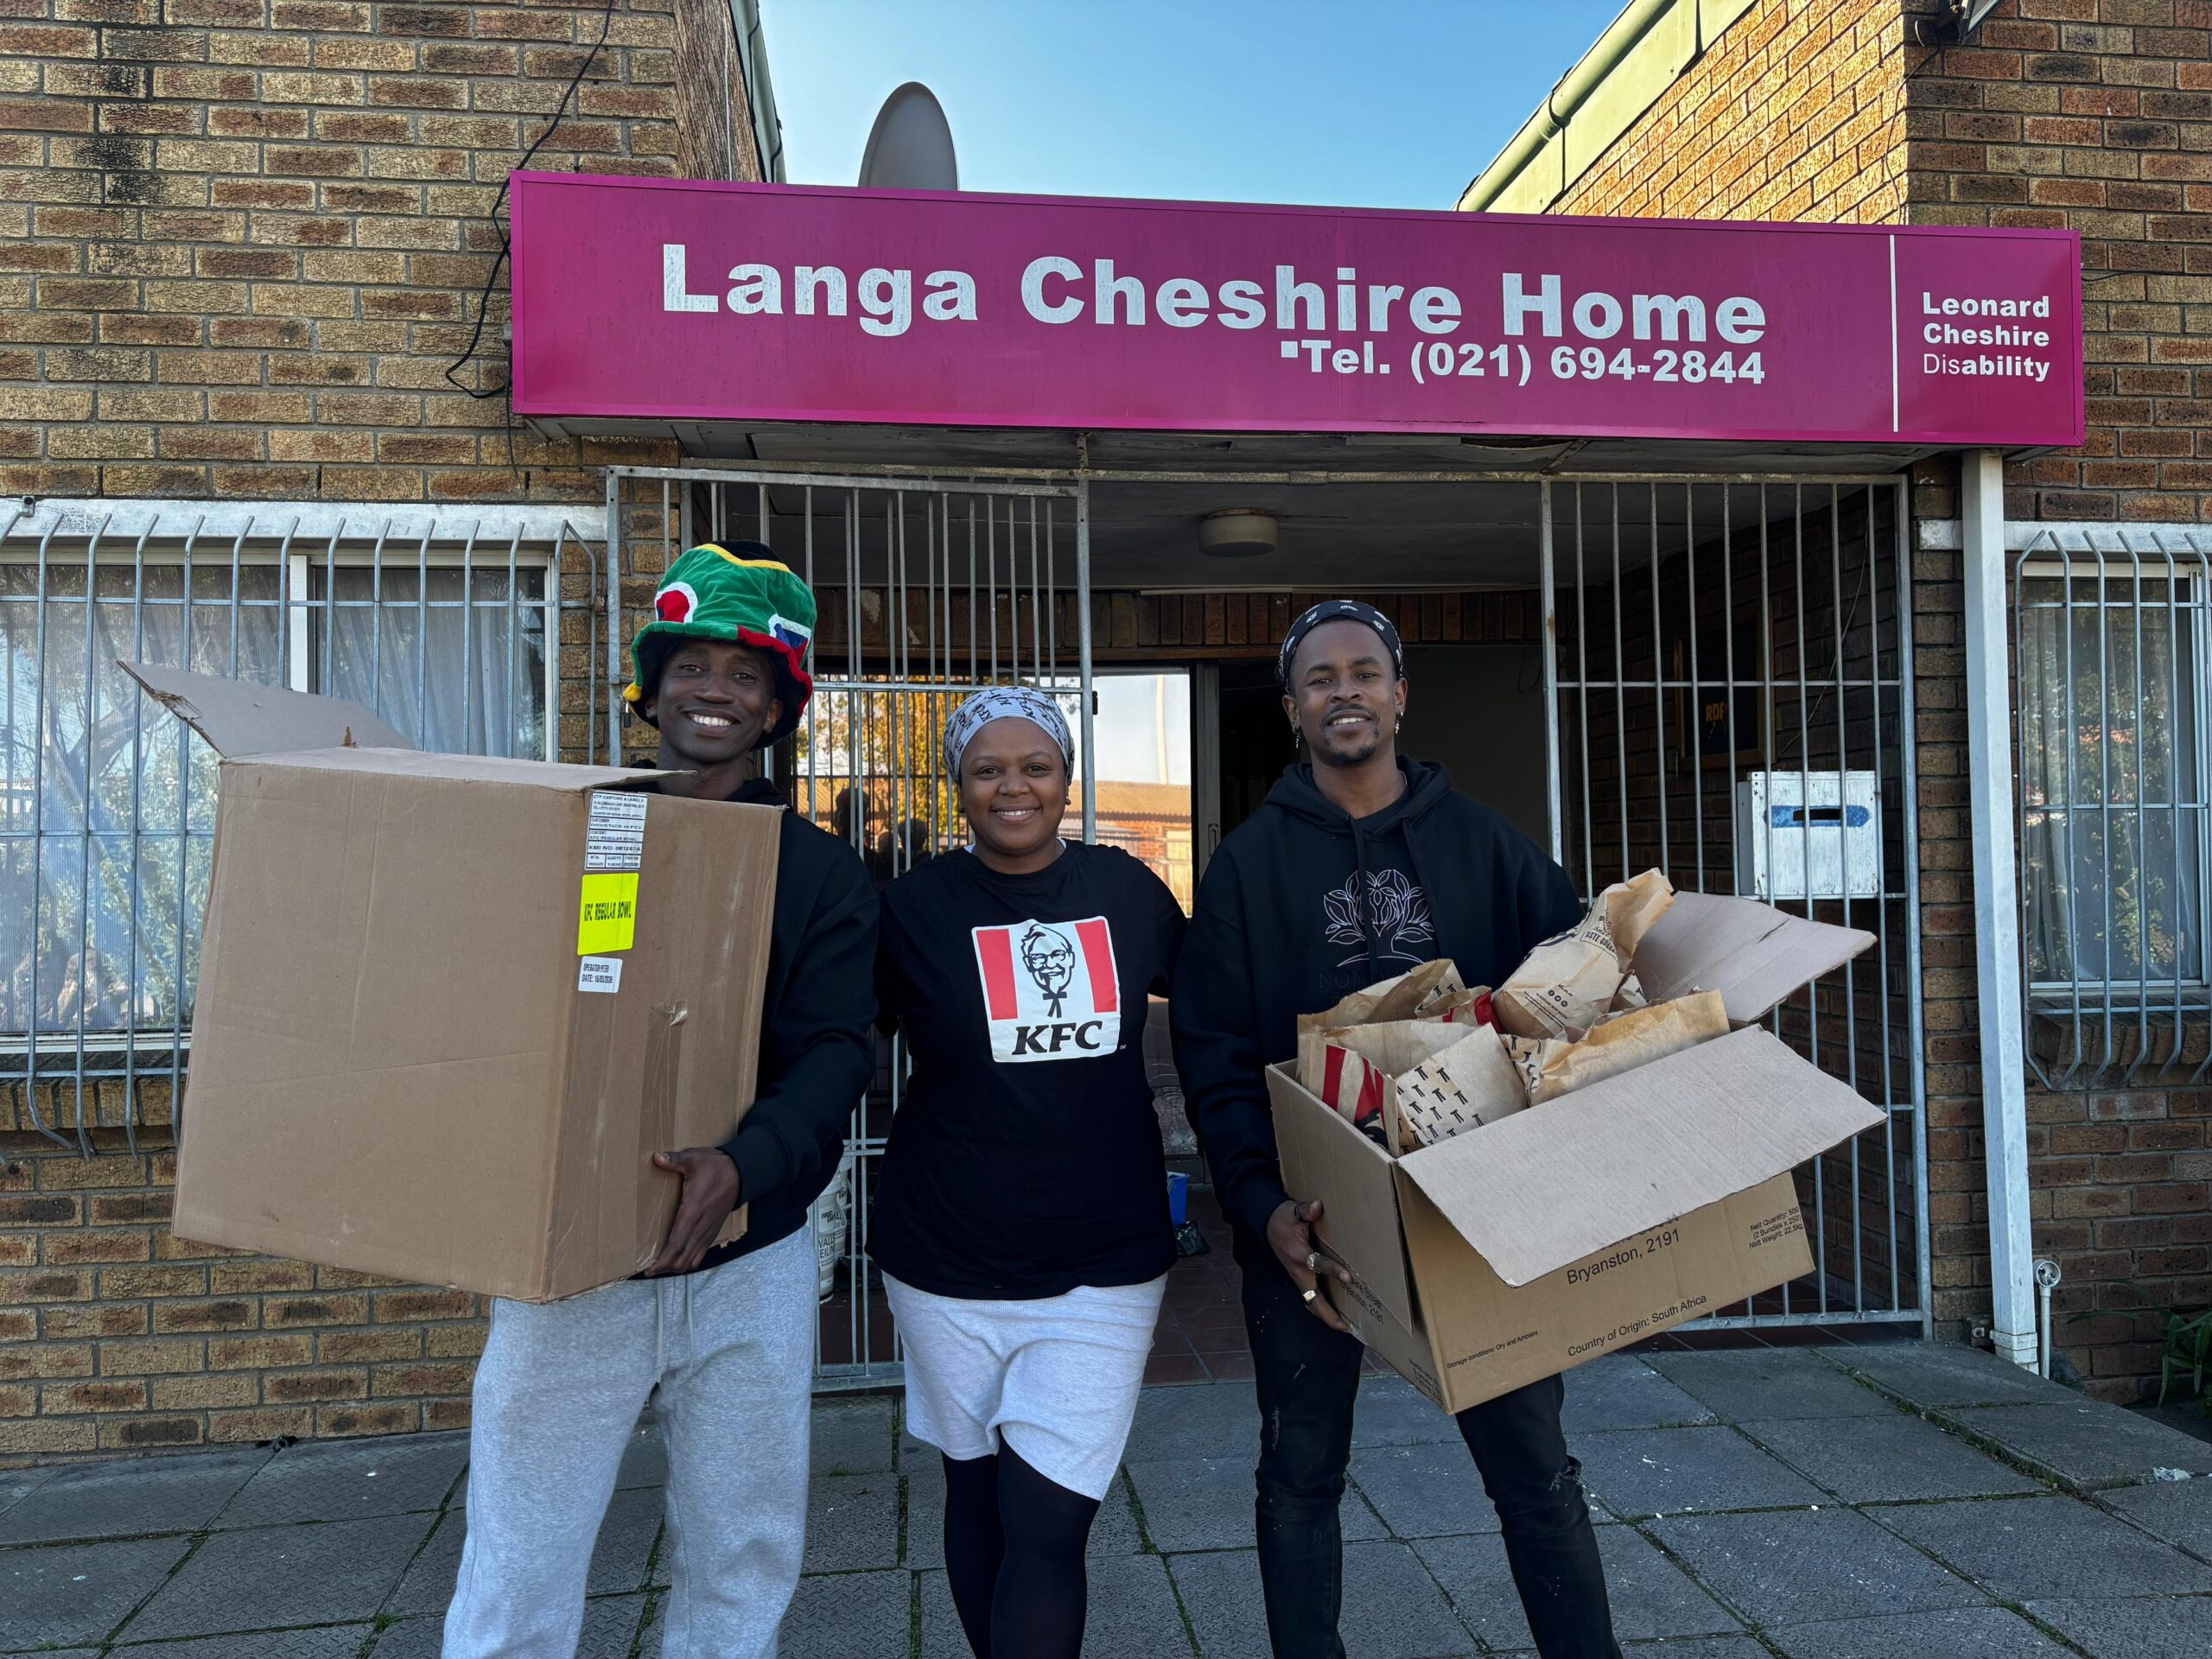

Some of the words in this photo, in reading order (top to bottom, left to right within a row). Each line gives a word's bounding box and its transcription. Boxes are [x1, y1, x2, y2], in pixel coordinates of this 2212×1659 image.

[664, 244, 978, 336] Langa
[1021, 257, 1461, 334] Cheshire
[1503, 273, 1766, 345] Home
[1923, 291, 2050, 318] Leonard
[1923, 322, 2050, 347] Cheshire
[1411, 342, 1532, 386] (021)
[1551, 346, 1765, 385] 694-2844
[1923, 353, 2050, 382] Disability
[584, 903, 594, 921] KFC
[594, 902, 616, 920] REGULAR
[618, 901, 632, 918] BOWL
[1012, 1020, 1103, 1056] KFC
[1750, 1221, 1763, 1232] Nett
[1763, 1212, 1788, 1227] Quantity:
[1789, 1206, 1800, 1216] 500
[1753, 1230, 1759, 1240] (2
[1760, 1223, 1783, 1236] Bundles
[1788, 1215, 1802, 1225] 250)
[1749, 1240, 1762, 1249] Nett
[1762, 1230, 1783, 1244] Weight:
[1784, 1223, 1803, 1235] 22.5kg
[1567, 1247, 1643, 1285] Bryanston,
[1646, 1228, 1680, 1254] 2191
[1567, 1334, 1605, 1357] Country
[1606, 1330, 1618, 1342] of
[1618, 1317, 1650, 1334] Origin:
[1651, 1306, 1680, 1324] South
[1680, 1294, 1707, 1312] Africa
[1446, 1357, 1468, 1369] Storage
[1468, 1346, 1496, 1362] conditions:
[1496, 1343, 1506, 1351] Dry
[1516, 1330, 1538, 1344] Ambient
